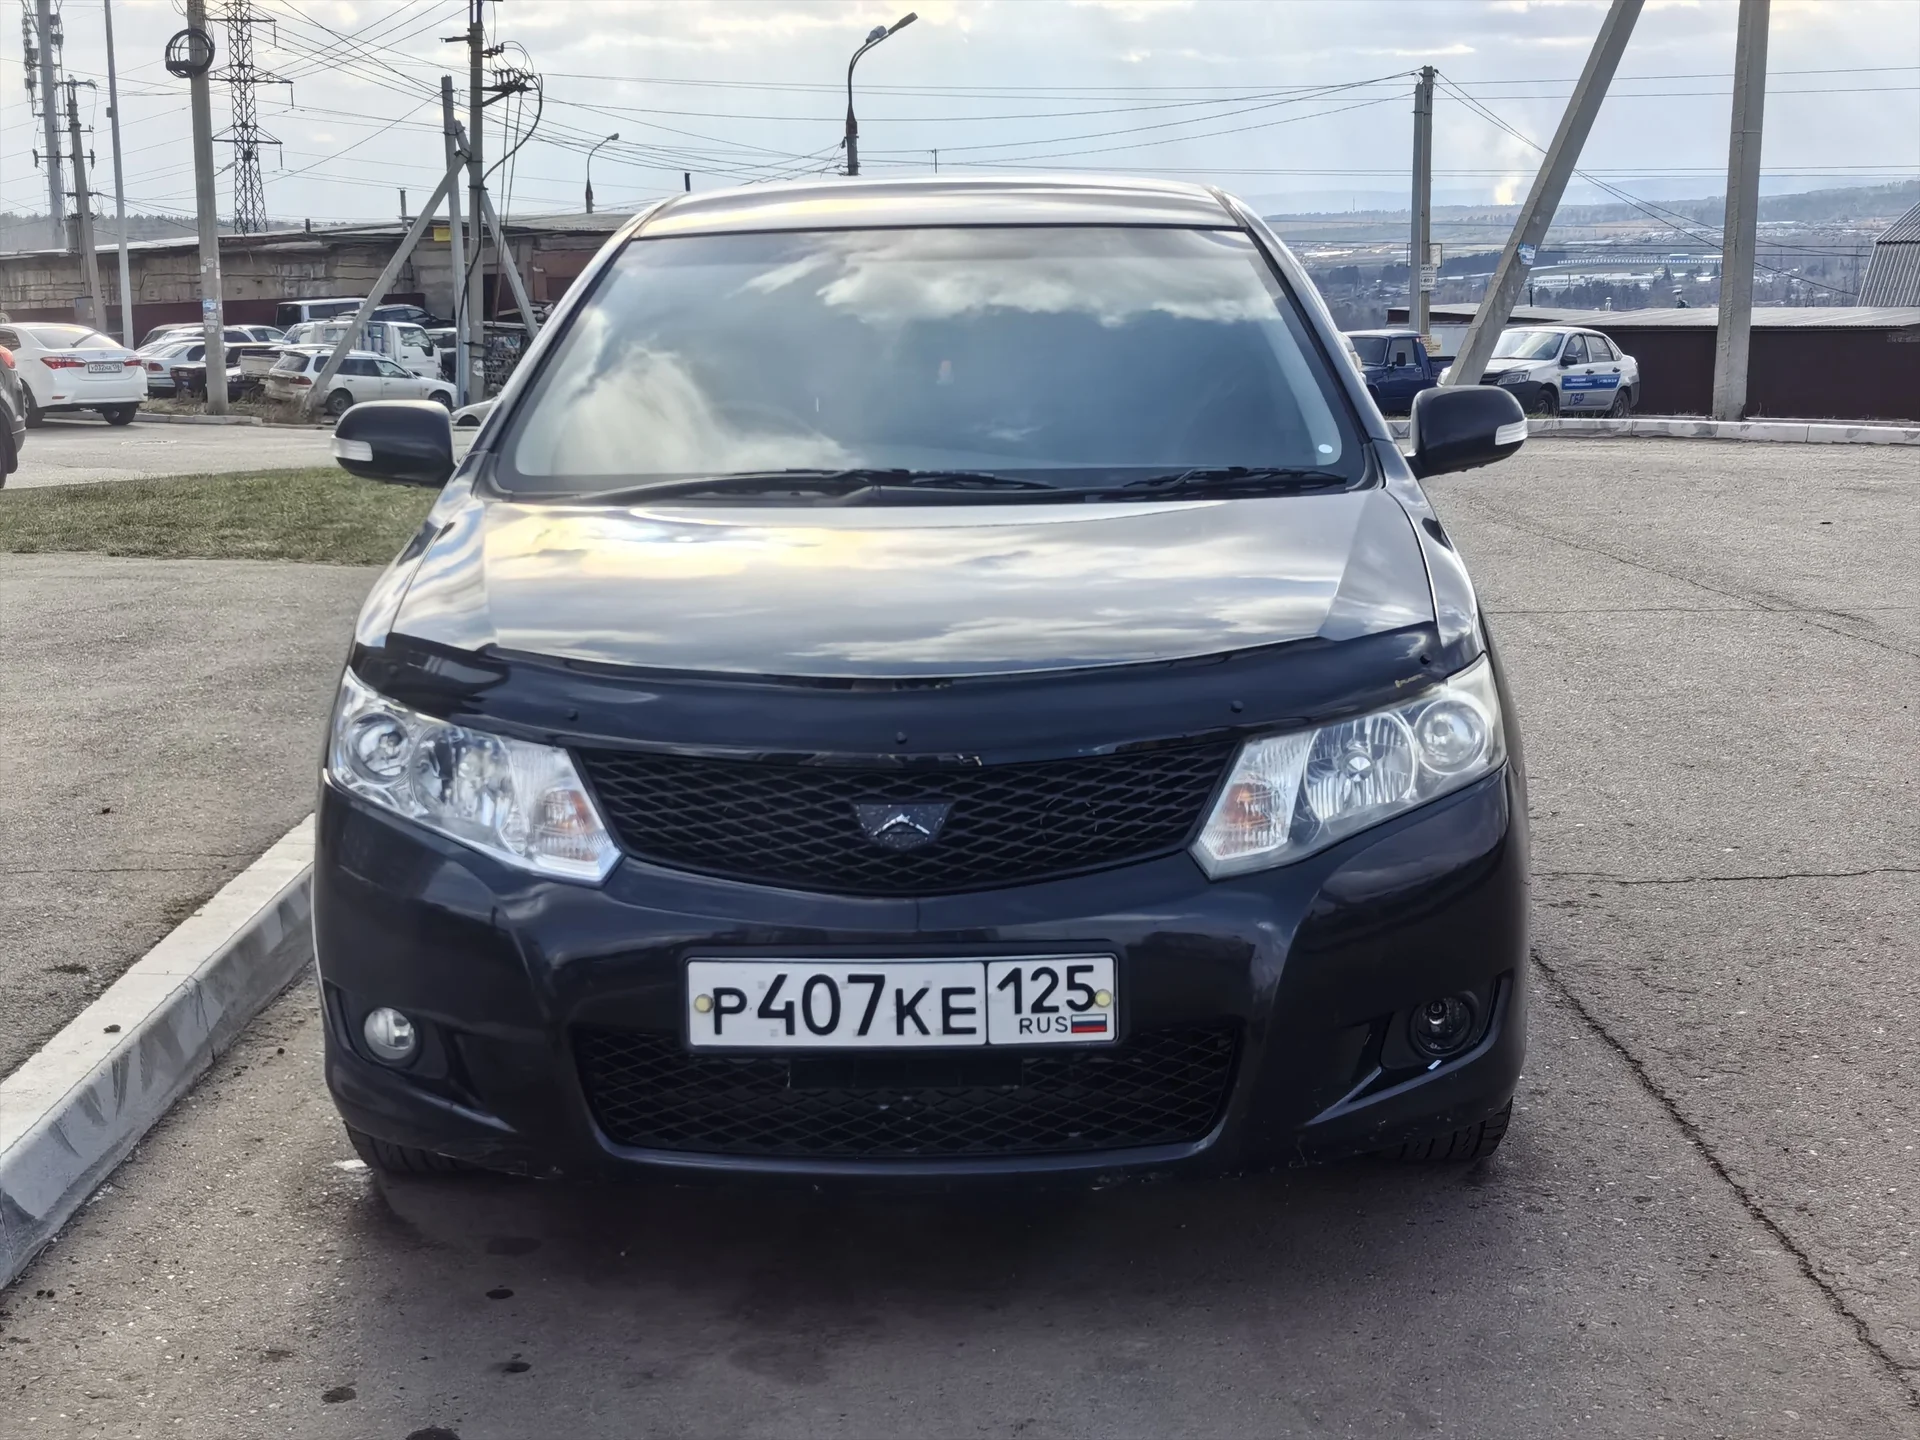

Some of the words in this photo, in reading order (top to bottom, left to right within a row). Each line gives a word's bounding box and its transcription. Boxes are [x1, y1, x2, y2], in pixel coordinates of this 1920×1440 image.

[713, 973, 977, 1036] Р407КЕ
[996, 965, 1096, 1014] 125
[1019, 1015, 1069, 1034] RUS
